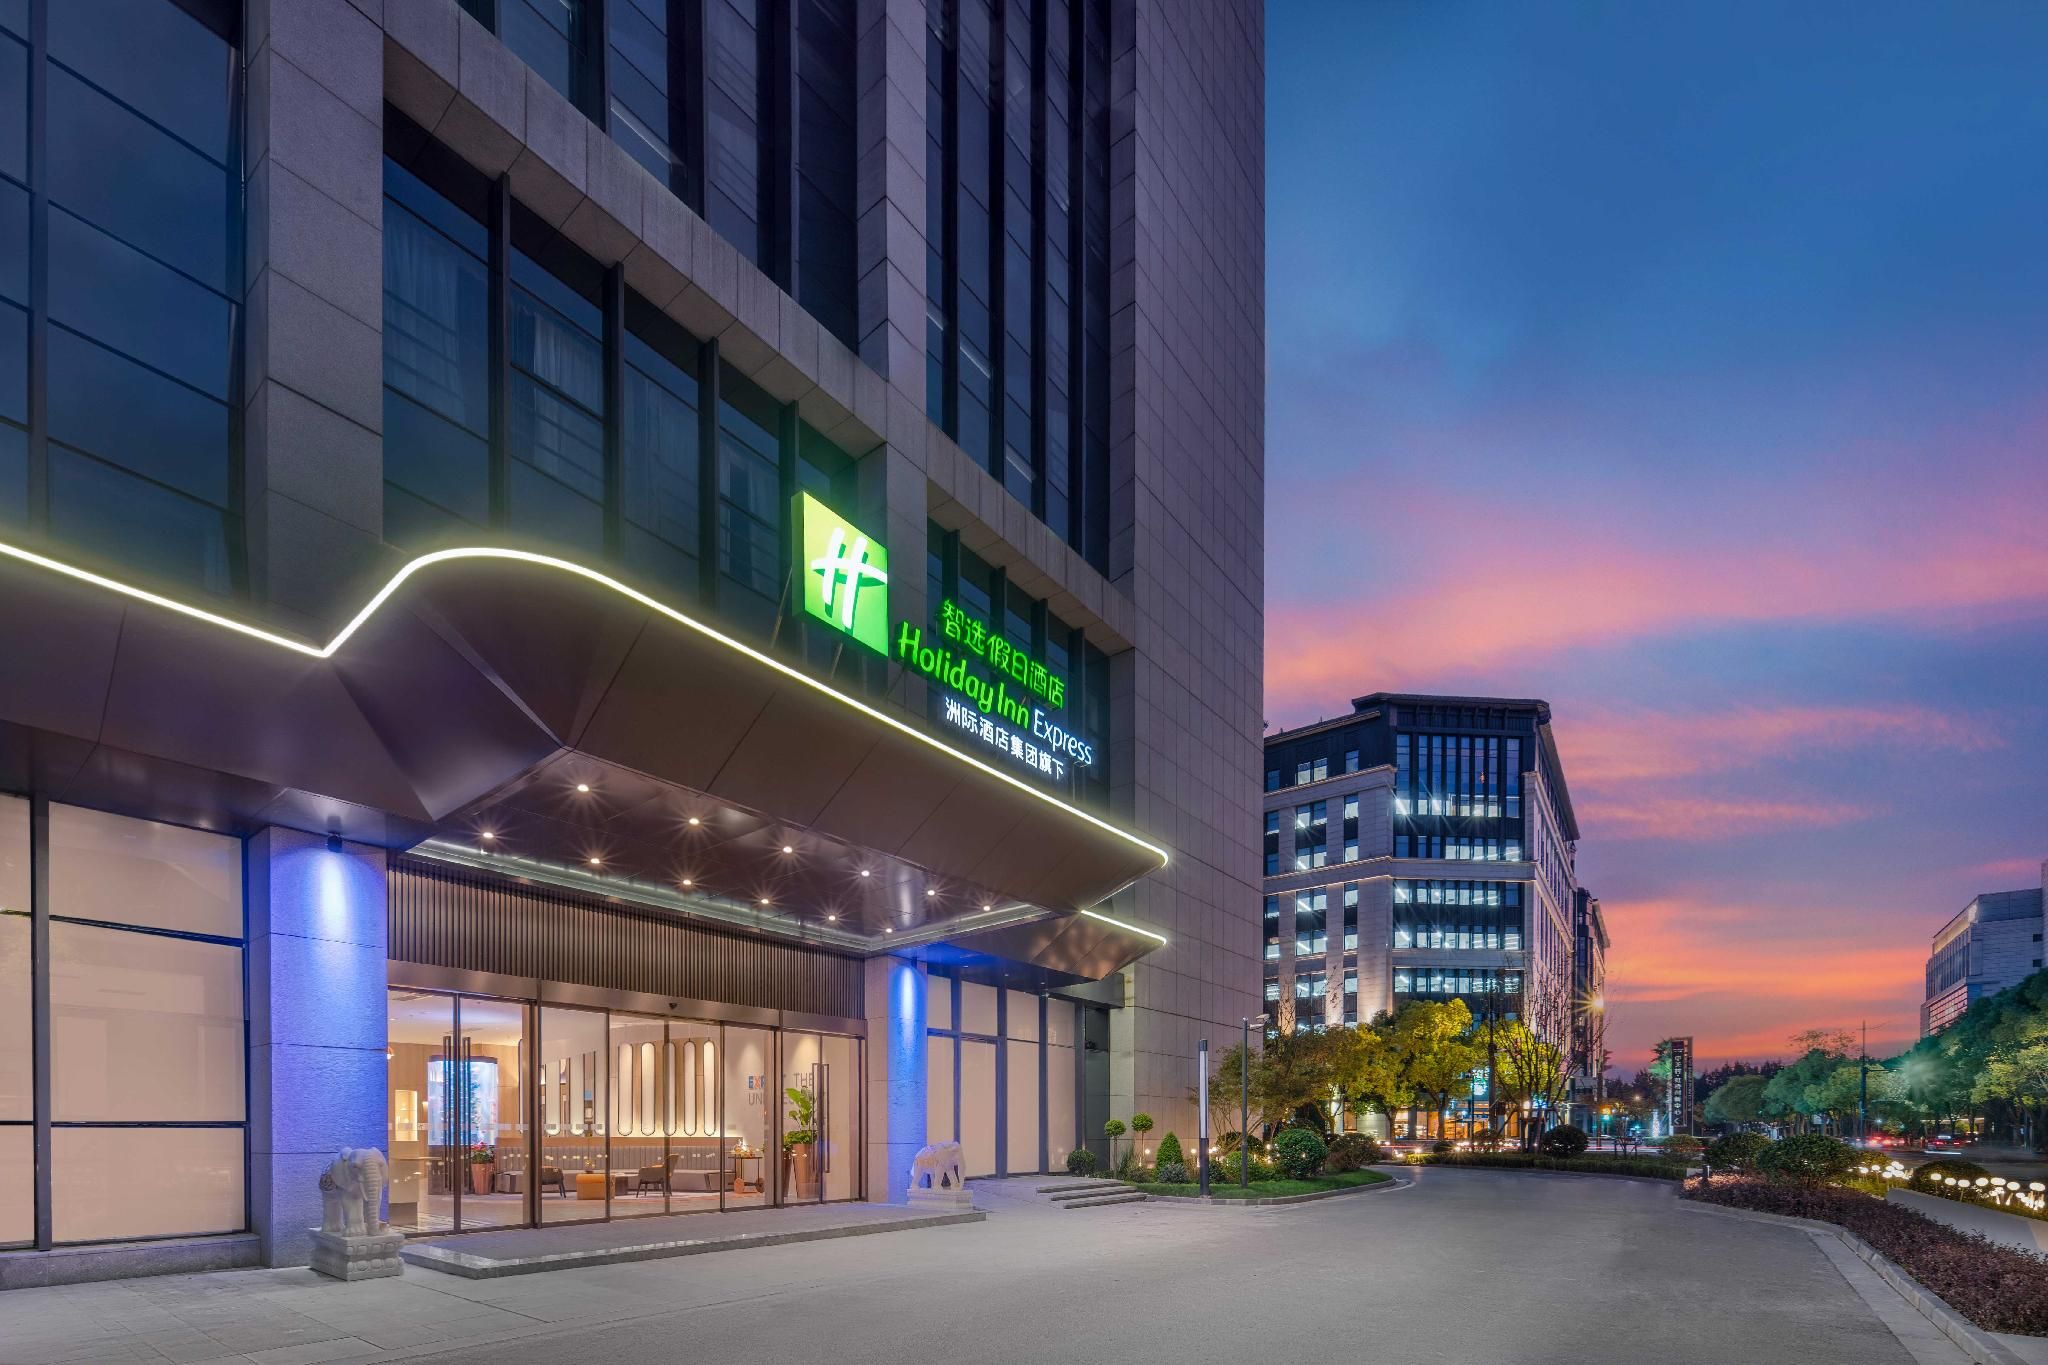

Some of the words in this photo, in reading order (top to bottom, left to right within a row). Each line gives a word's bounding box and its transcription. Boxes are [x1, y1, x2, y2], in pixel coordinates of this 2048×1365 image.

[898, 621, 993, 714] Holiday
[998, 682, 1029, 729] Inn
[1033, 708, 1092, 765] Express
[942, 598, 1065, 709] 智选假日酒店
[945, 696, 1064, 780] 洲际酒店集团旗下
